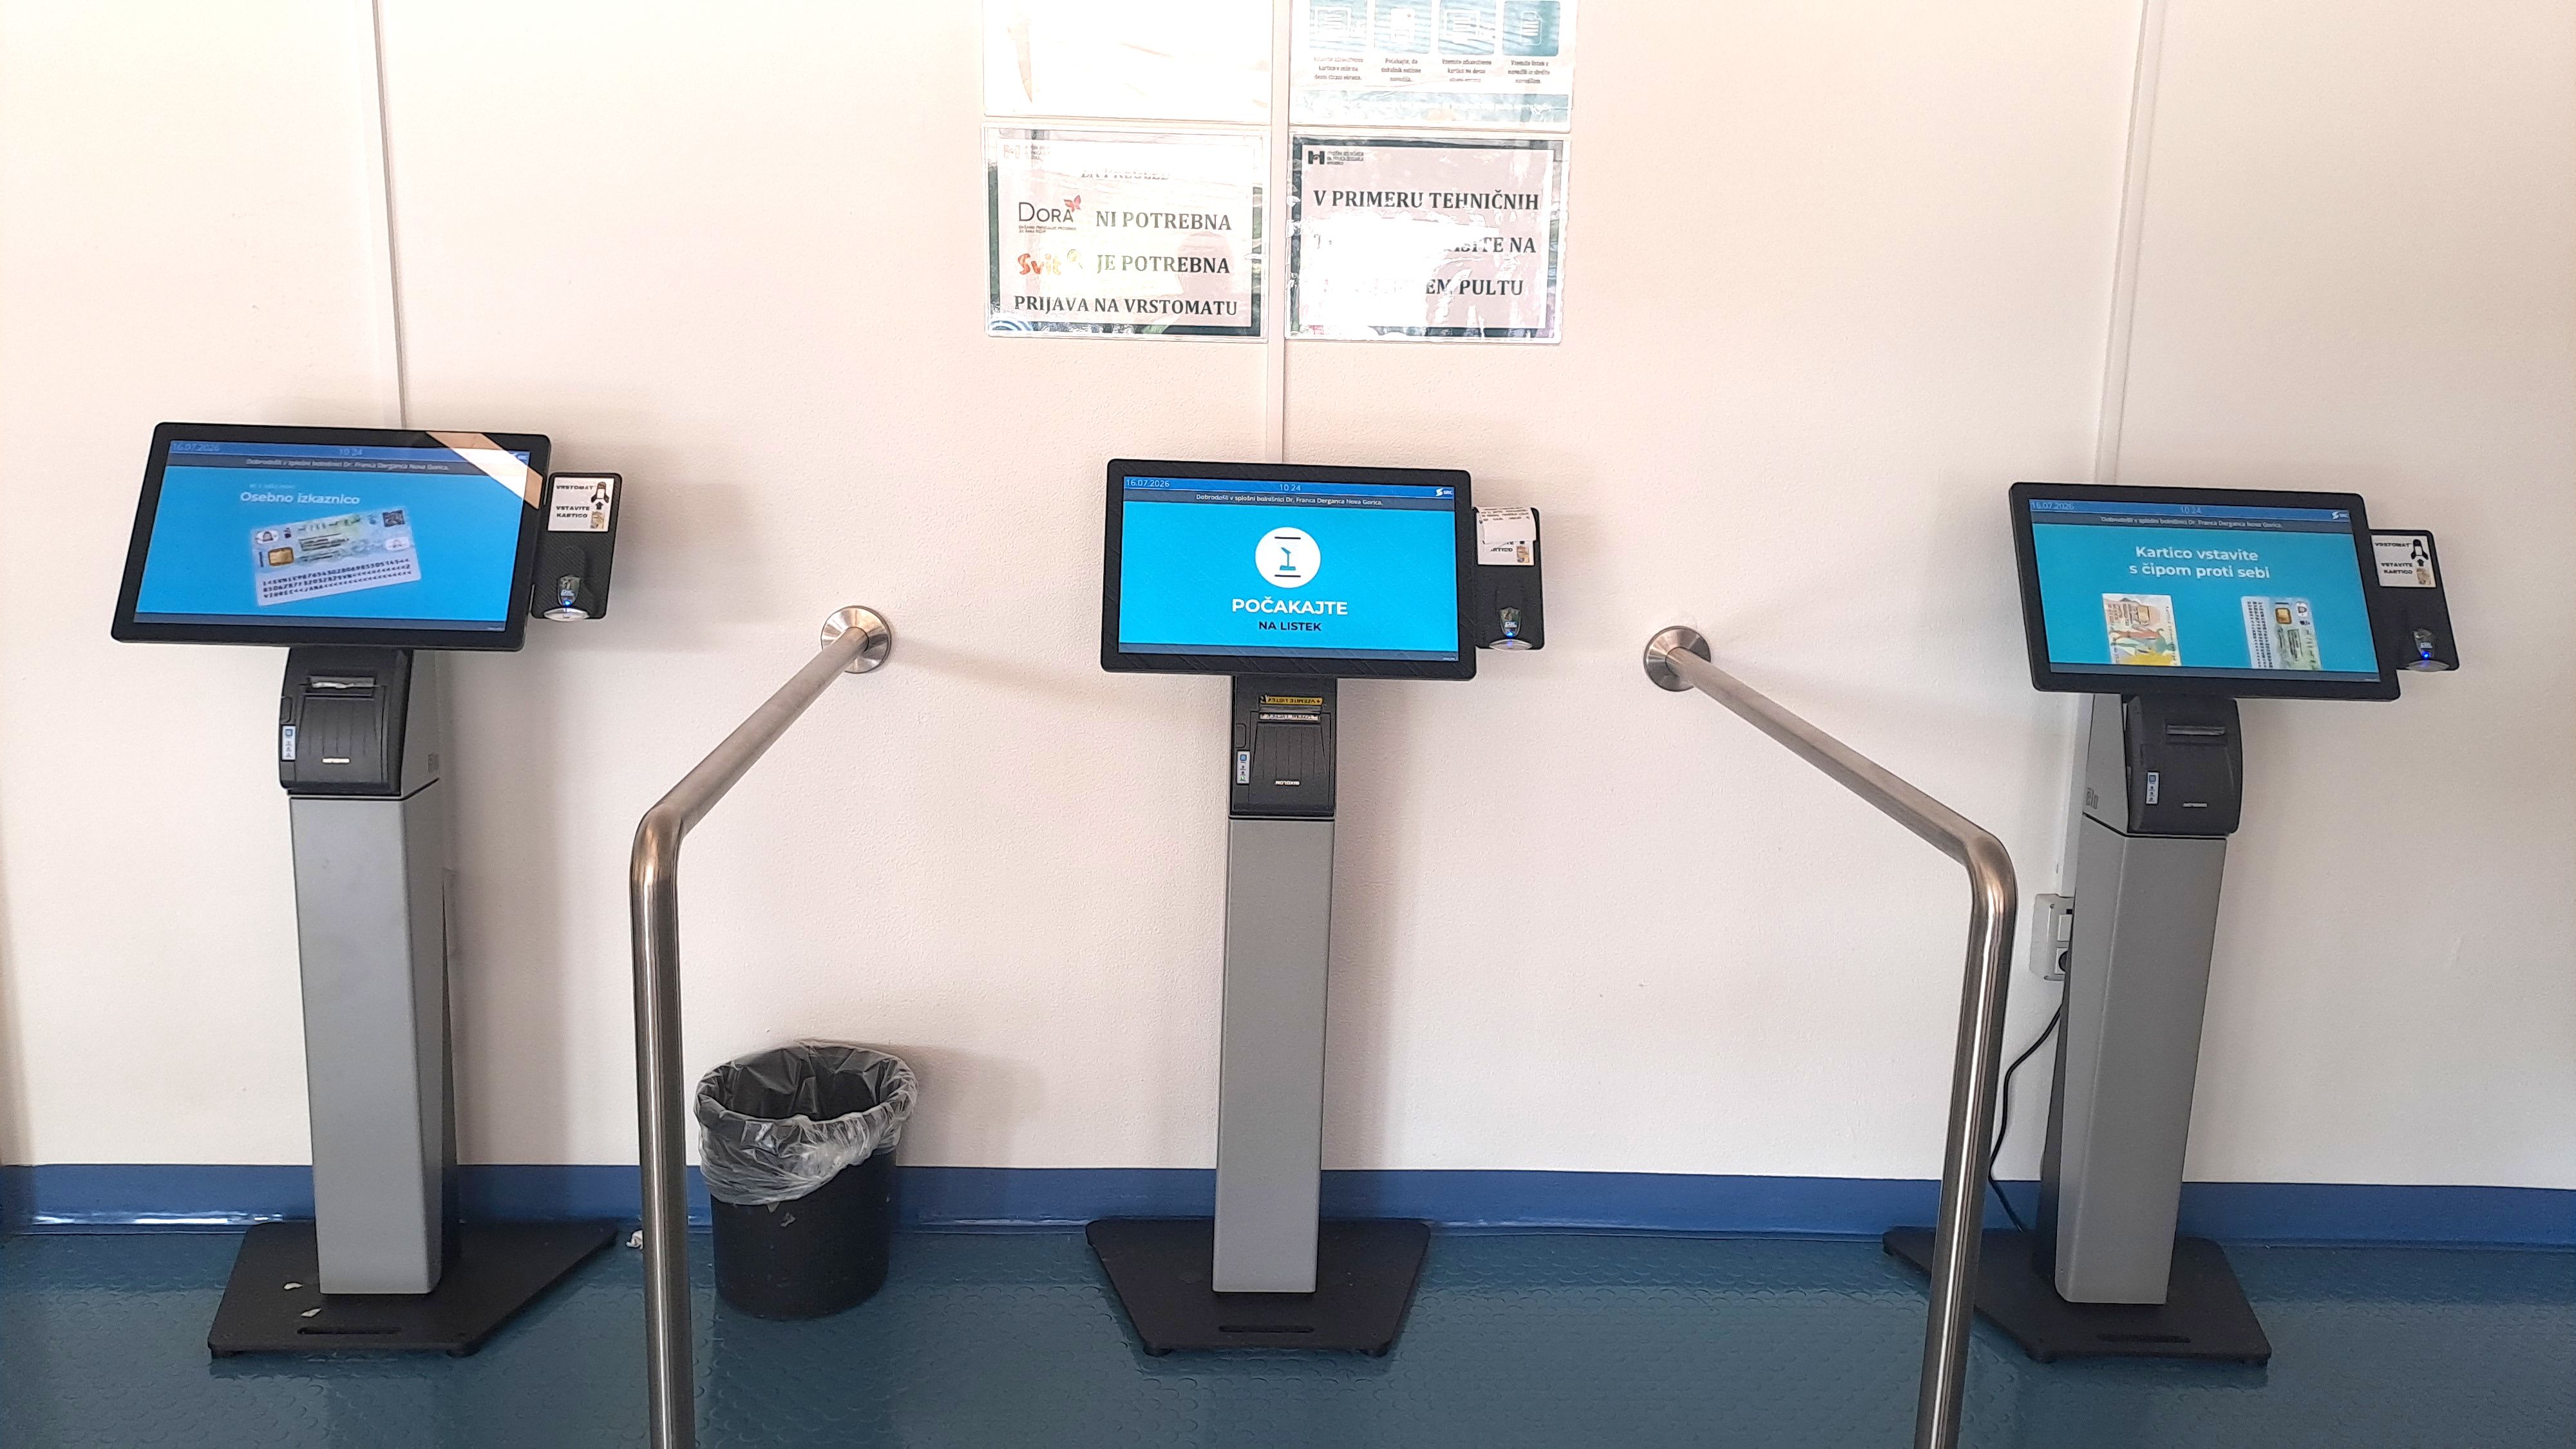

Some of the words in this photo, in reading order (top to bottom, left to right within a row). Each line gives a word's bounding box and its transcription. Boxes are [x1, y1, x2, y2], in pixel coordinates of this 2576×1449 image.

[1313, 191, 1327, 207] V
[1332, 191, 1424, 208] PRIMERU
[1429, 189, 1539, 211] TEHNIČNIH
[1096, 211, 1115, 227] NI
[1122, 212, 1232, 231] POTREBNA
[1510, 237, 1537, 253] NA
[1097, 254, 1115, 274] JE
[1122, 255, 1230, 274] POTREBNA
[1459, 279, 1524, 296] PULTU
[1014, 295, 1089, 314] PRIJAVA
[1095, 298, 1119, 312] NA
[1124, 299, 1238, 316] VRSTOMATU
[240, 491, 293, 503] Osebno
[297, 492, 360, 504] izkaznico
[2136, 545, 2193, 559] Kartico
[2197, 548, 2259, 561] vstavite
[2129, 564, 2138, 574] s
[2142, 562, 2192, 578] čipom
[2196, 565, 2234, 578] proti
[2238, 566, 2270, 578] sebi
[1232, 596, 1349, 616] POČAKAJTE
[1258, 621, 1277, 630] NA
[1280, 621, 1322, 631] LISTEK
